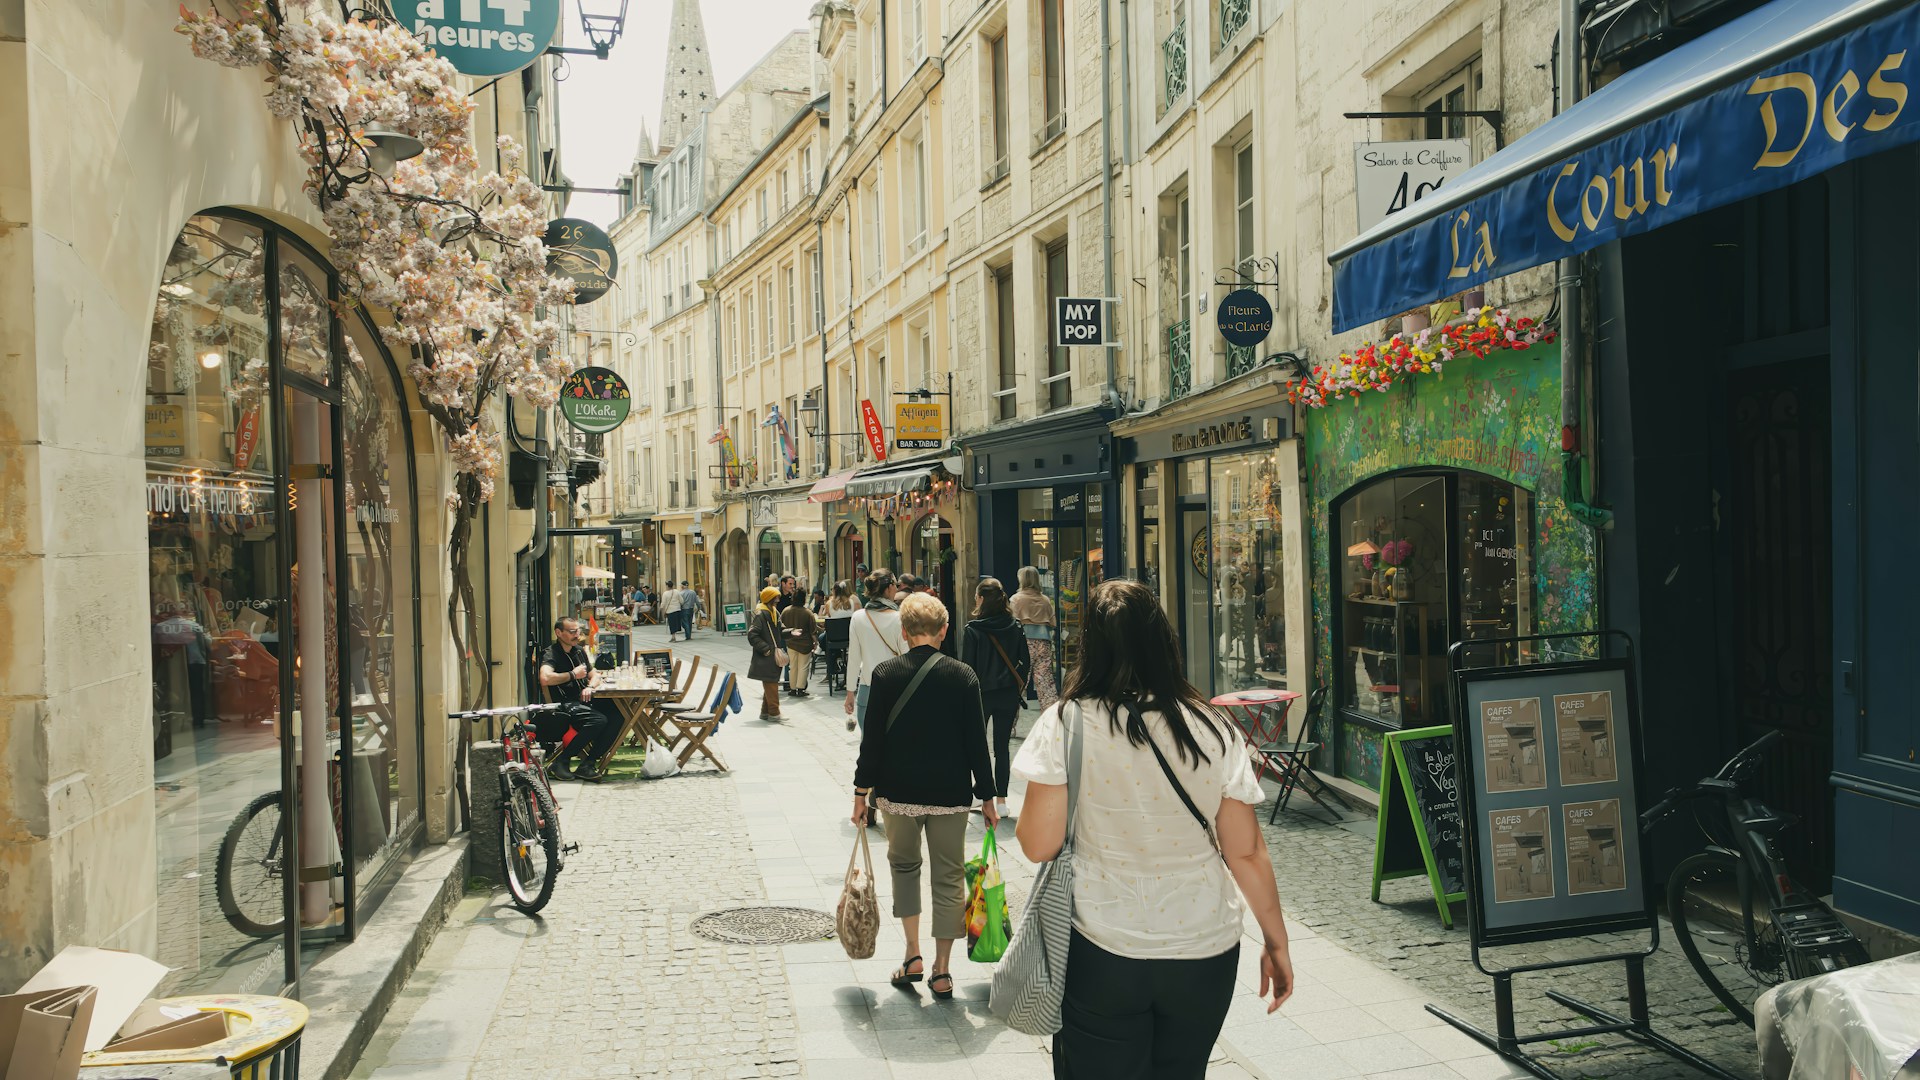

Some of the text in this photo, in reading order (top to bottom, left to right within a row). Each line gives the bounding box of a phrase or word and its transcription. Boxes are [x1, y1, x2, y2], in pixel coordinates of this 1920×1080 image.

[414, 19, 535, 53] heures
[1363, 149, 1462, 171] Salon de Coiffure
[1447, 48, 1909, 279] La Cour Des
[560, 225, 584, 240] 26
[1065, 304, 1096, 320] MY
[1228, 305, 1261, 316] Fleurs
[1064, 324, 1097, 339] POP
[864, 406, 884, 453] TABAC
[899, 440, 939, 448] BAR TABAC
[978, 465, 985, 475] 6
